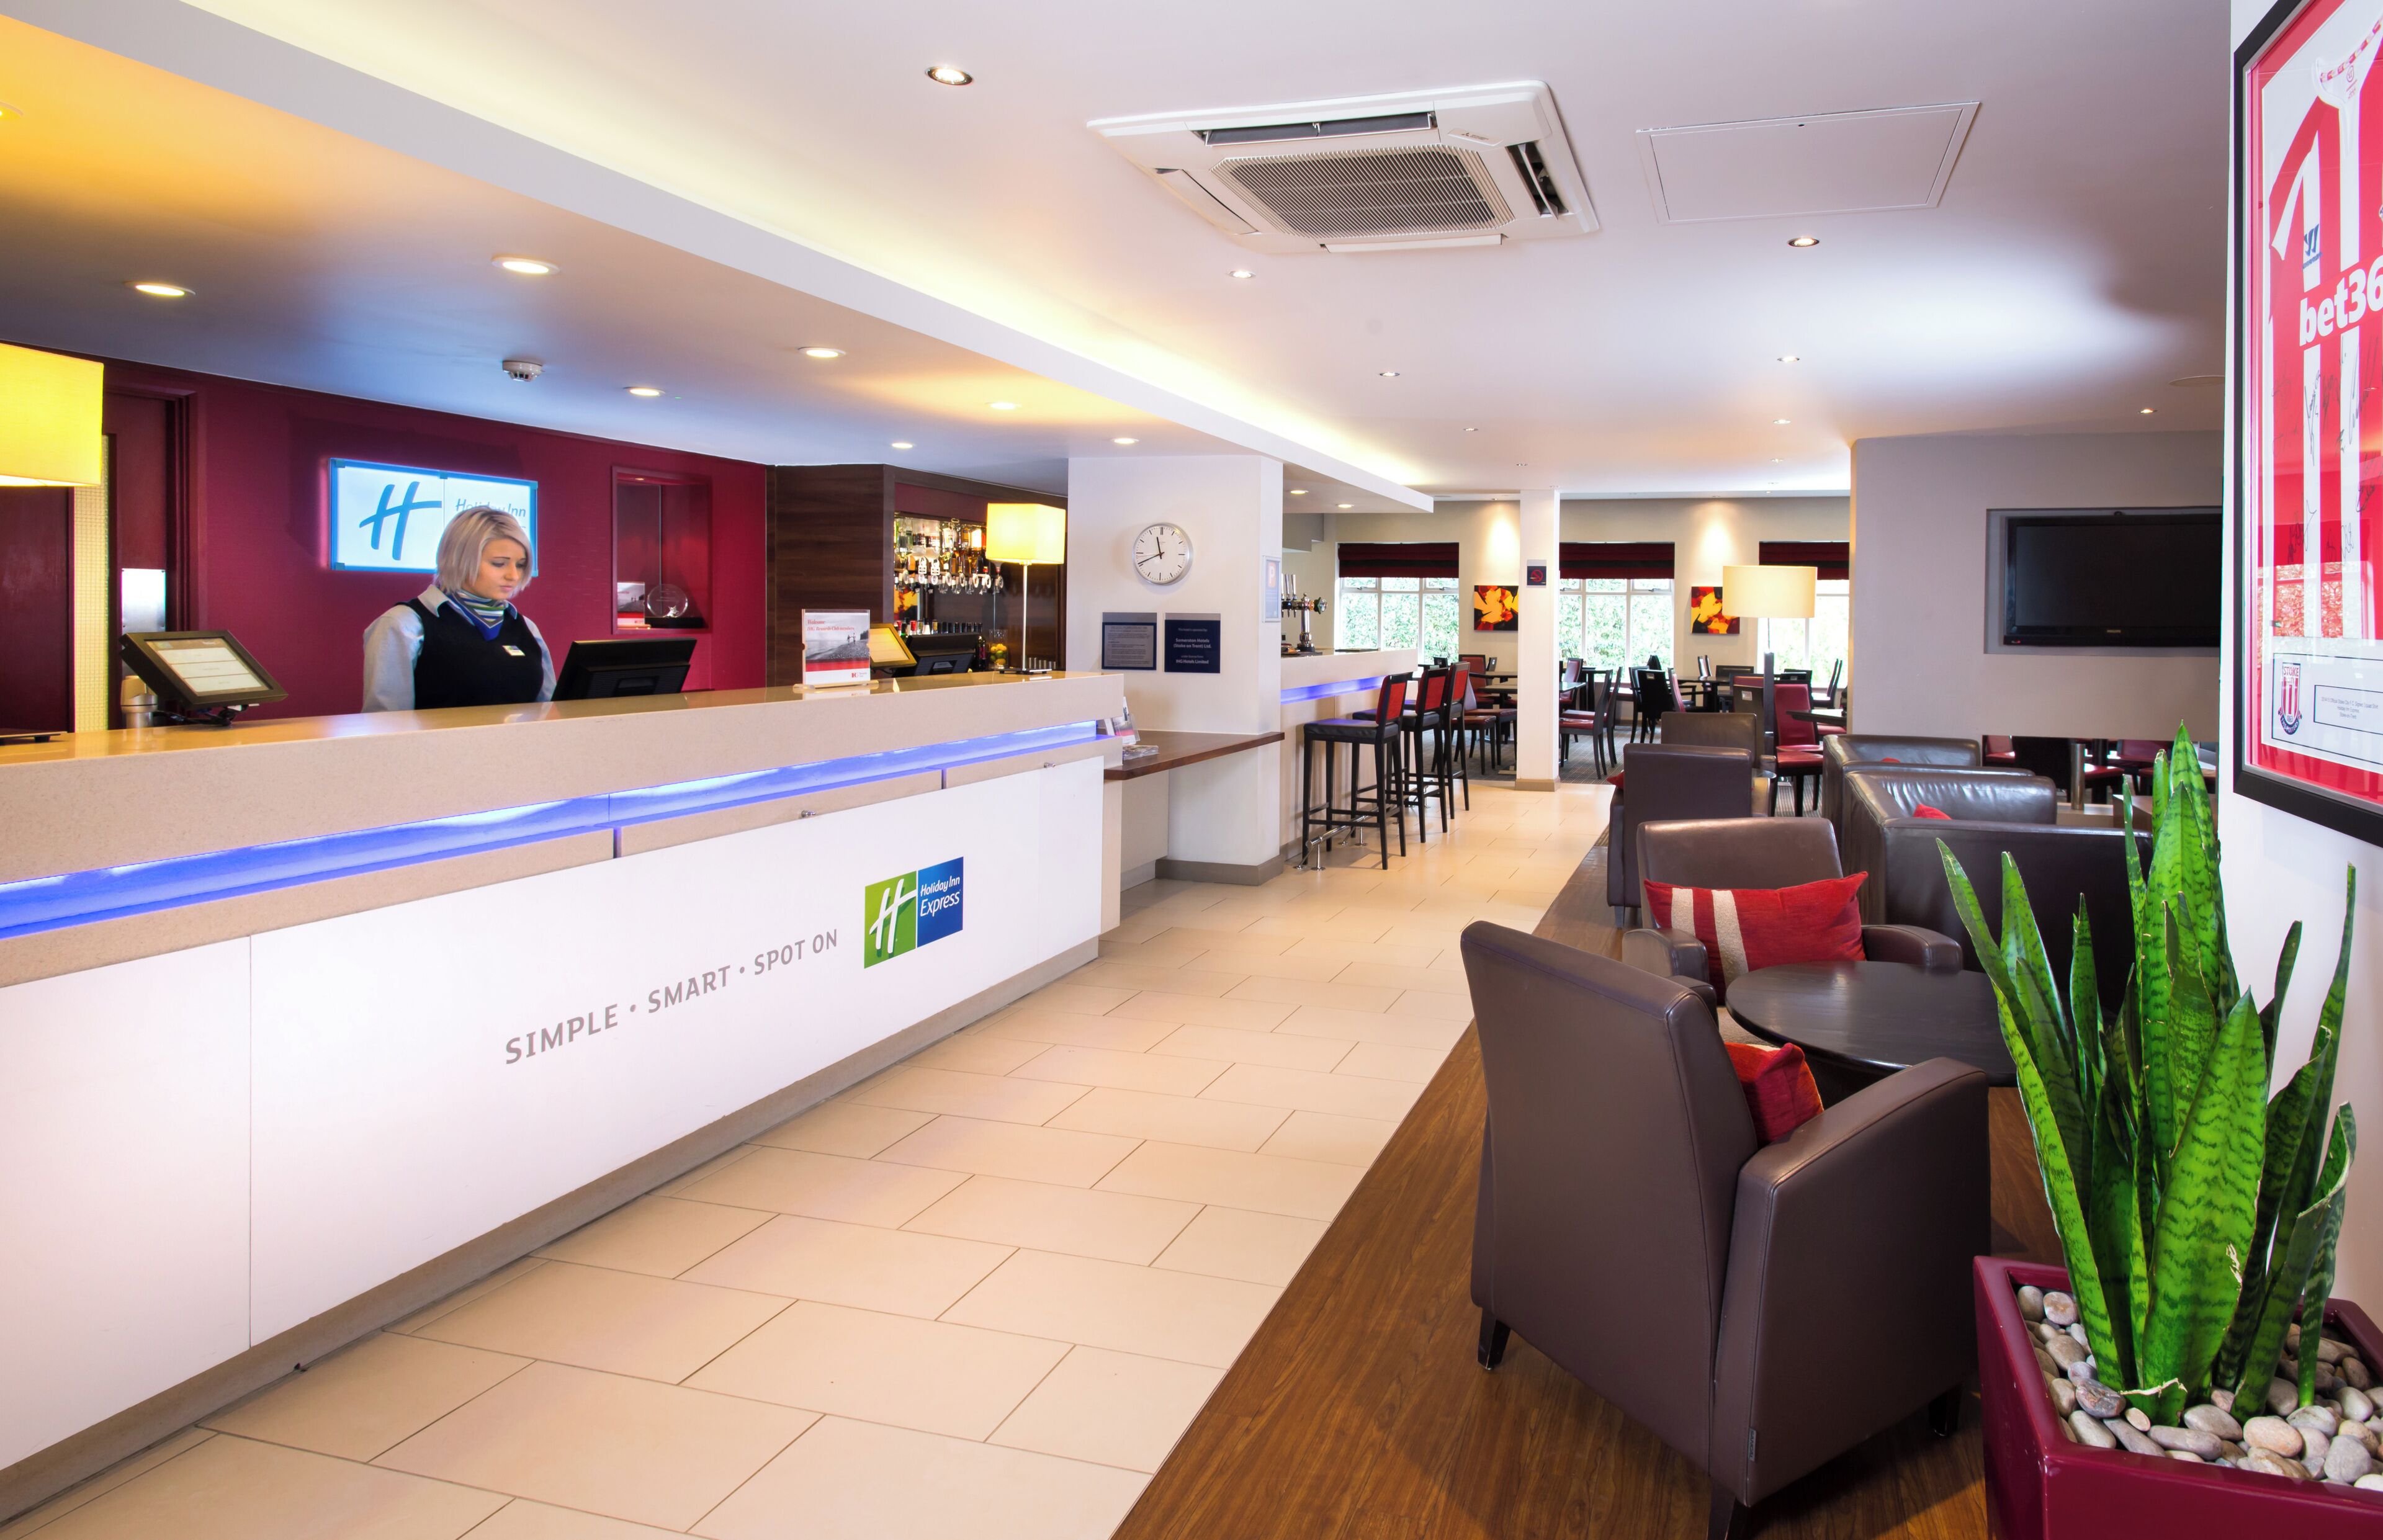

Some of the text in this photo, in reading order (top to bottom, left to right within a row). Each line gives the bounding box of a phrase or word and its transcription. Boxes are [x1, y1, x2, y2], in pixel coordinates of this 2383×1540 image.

[2283, 666, 2299, 677] STOKE
[920, 875, 961, 897] Holiday Inn
[920, 891, 960, 917] Express
[506, 929, 838, 1064] SIMPLE SMART SPOT ON
